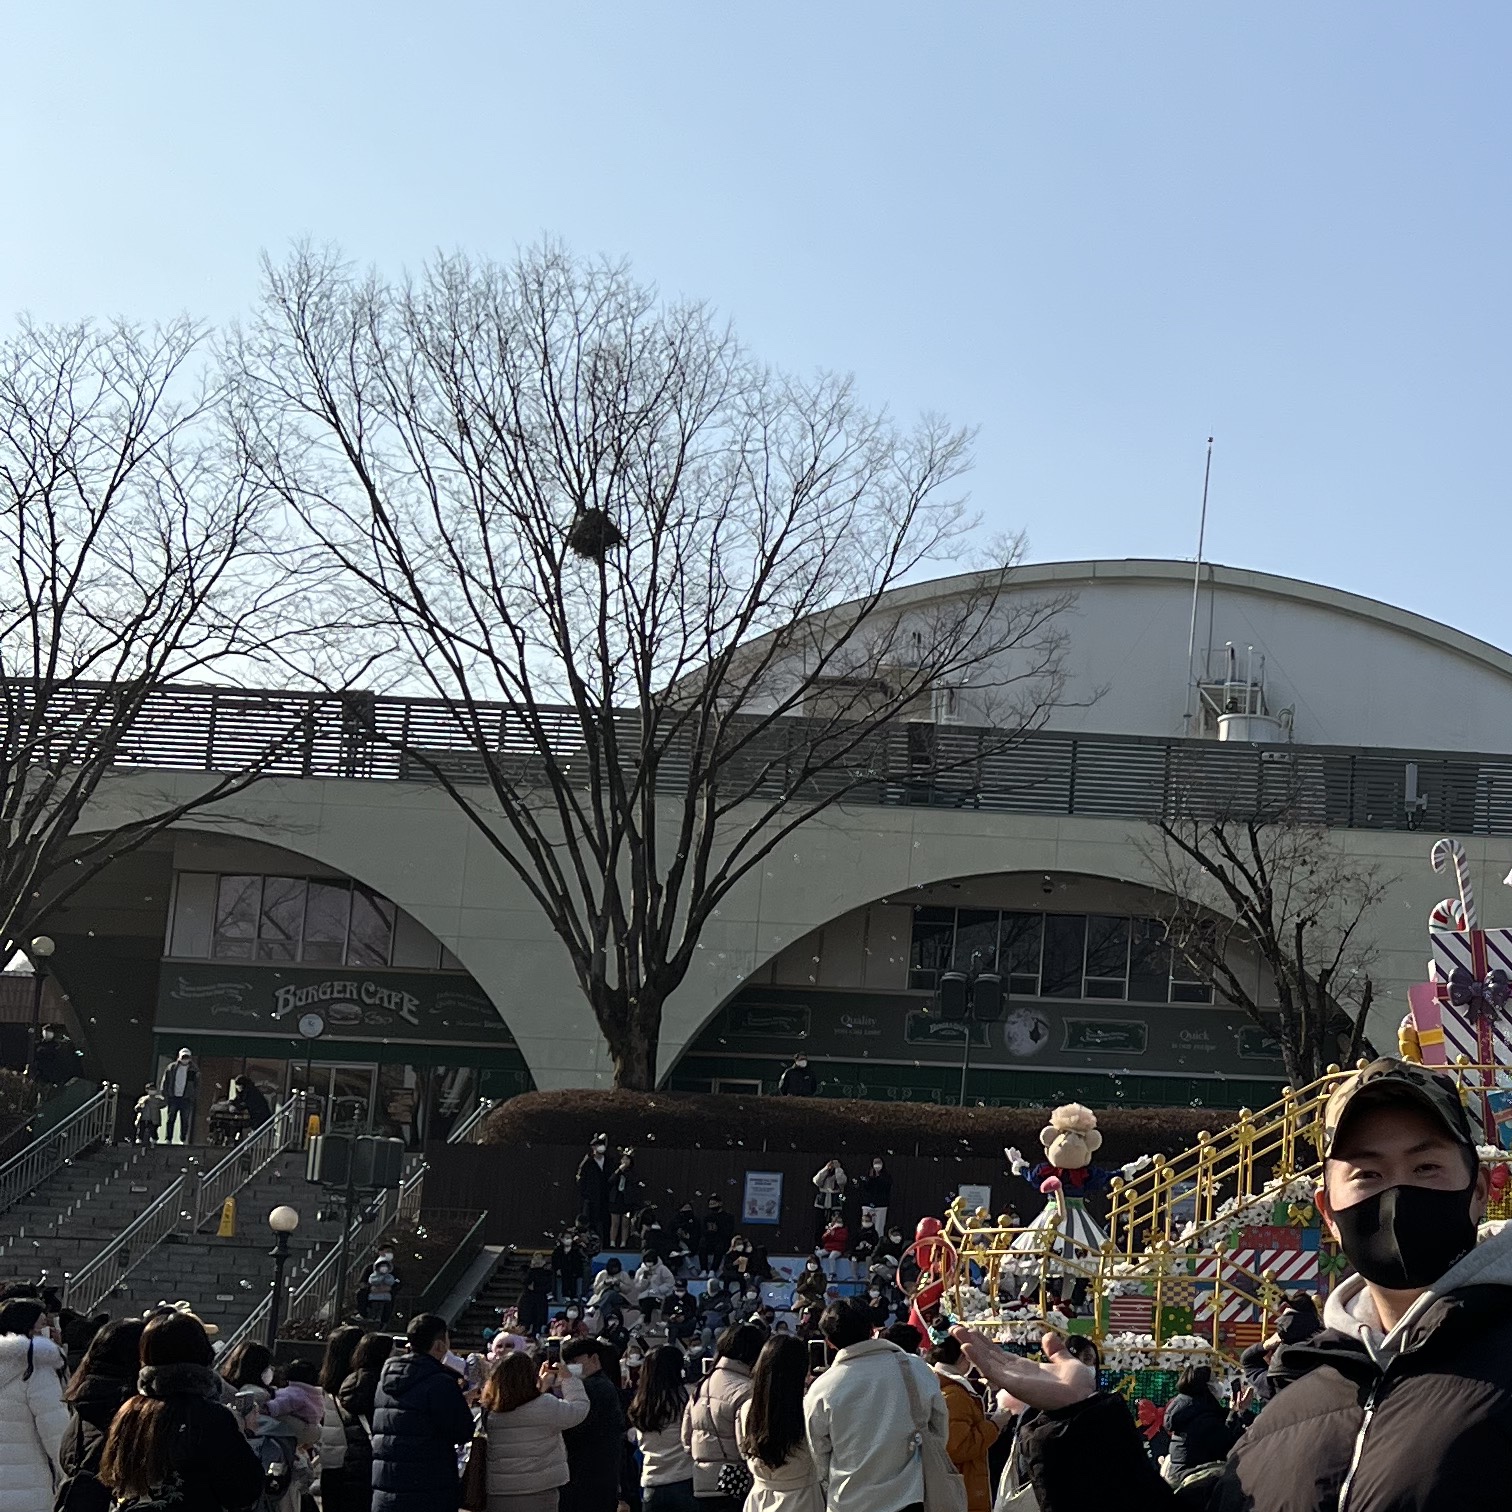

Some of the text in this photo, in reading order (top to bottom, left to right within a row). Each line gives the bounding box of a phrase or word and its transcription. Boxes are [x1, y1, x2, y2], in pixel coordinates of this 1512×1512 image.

[273, 980, 358, 1018] BURGER
[840, 1014, 878, 1027] Quality
[1179, 1029, 1210, 1044] Quick
